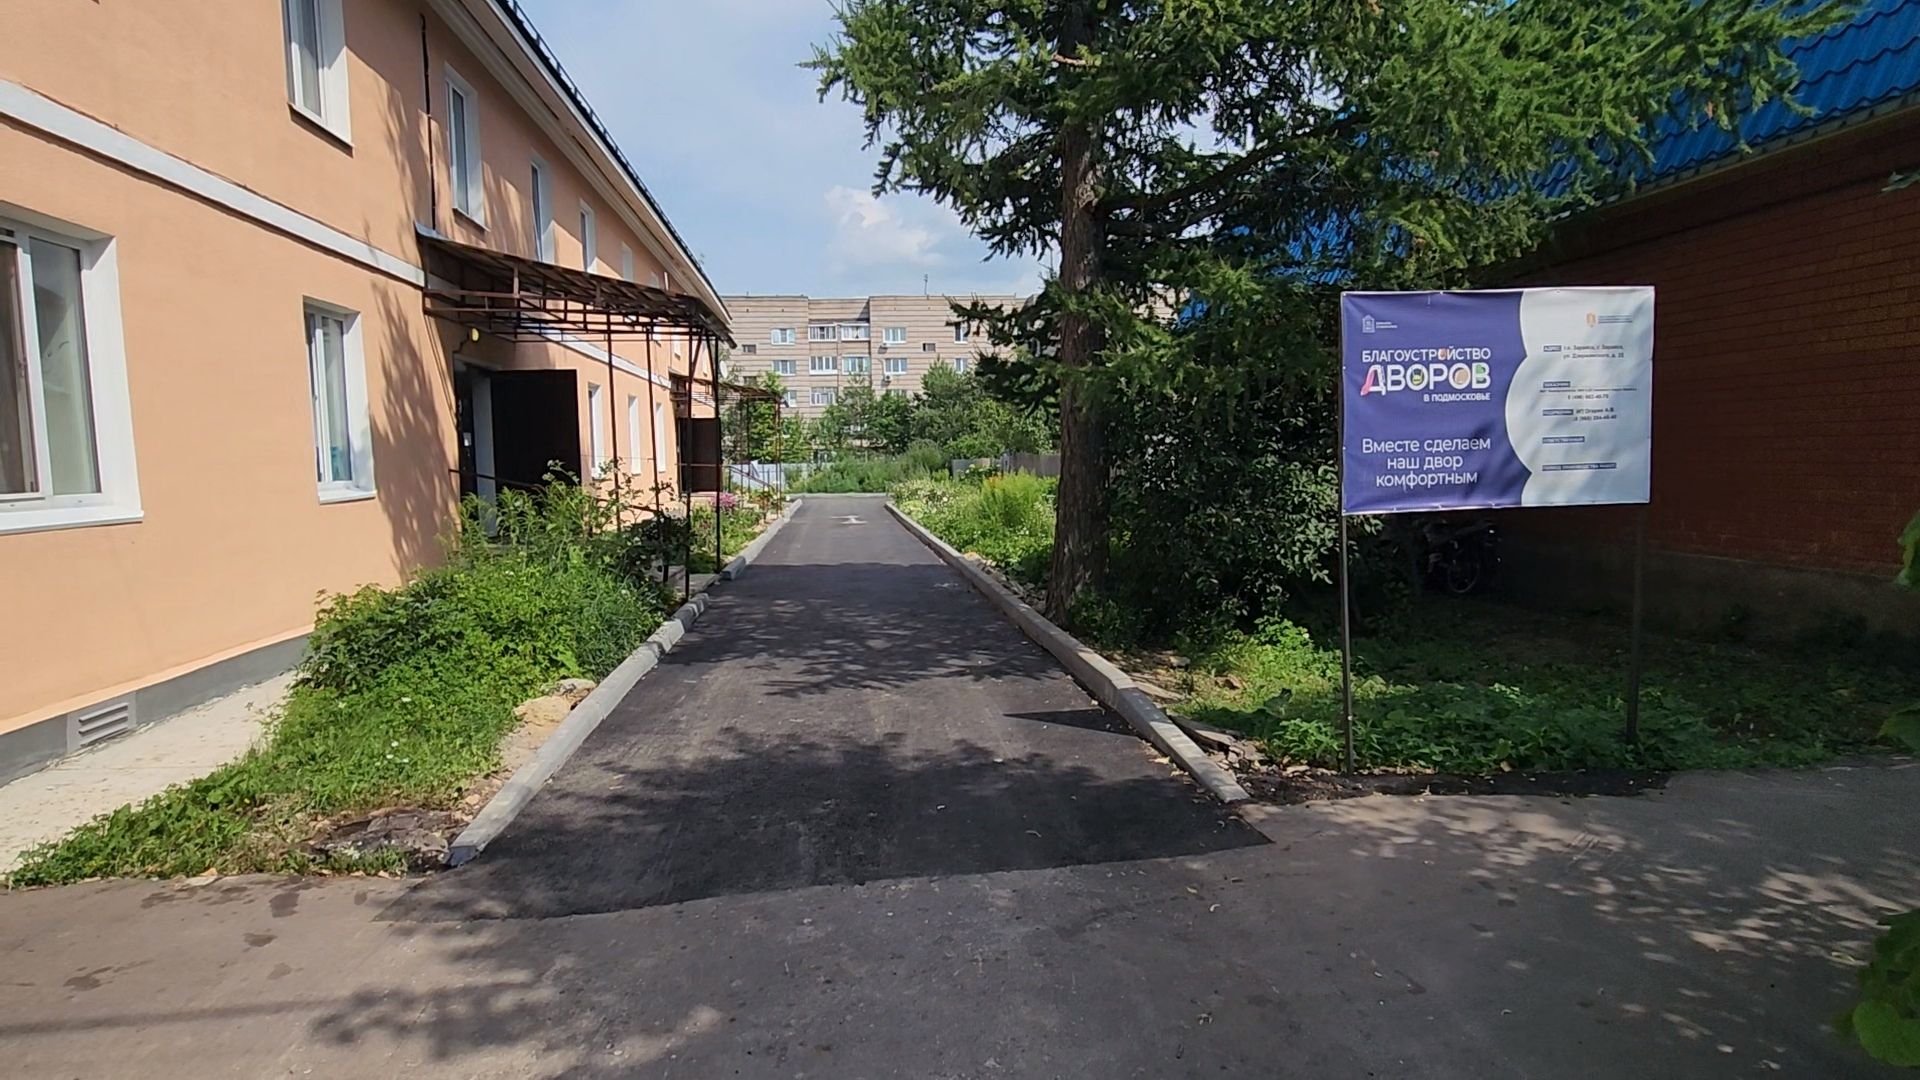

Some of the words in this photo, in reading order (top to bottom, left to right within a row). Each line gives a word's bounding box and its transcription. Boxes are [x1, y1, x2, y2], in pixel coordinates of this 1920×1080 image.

[1362, 346, 1491, 362] БЛАГОУСТРОЙСТВО
[1361, 362, 1491, 396] ДВОРОВ
[1362, 438, 1420, 454] Вместе
[1424, 437, 1491, 453] сделаем
[1387, 457, 1420, 470] наш
[1424, 456, 1463, 471] двор
[1376, 472, 1478, 489] комфортным
